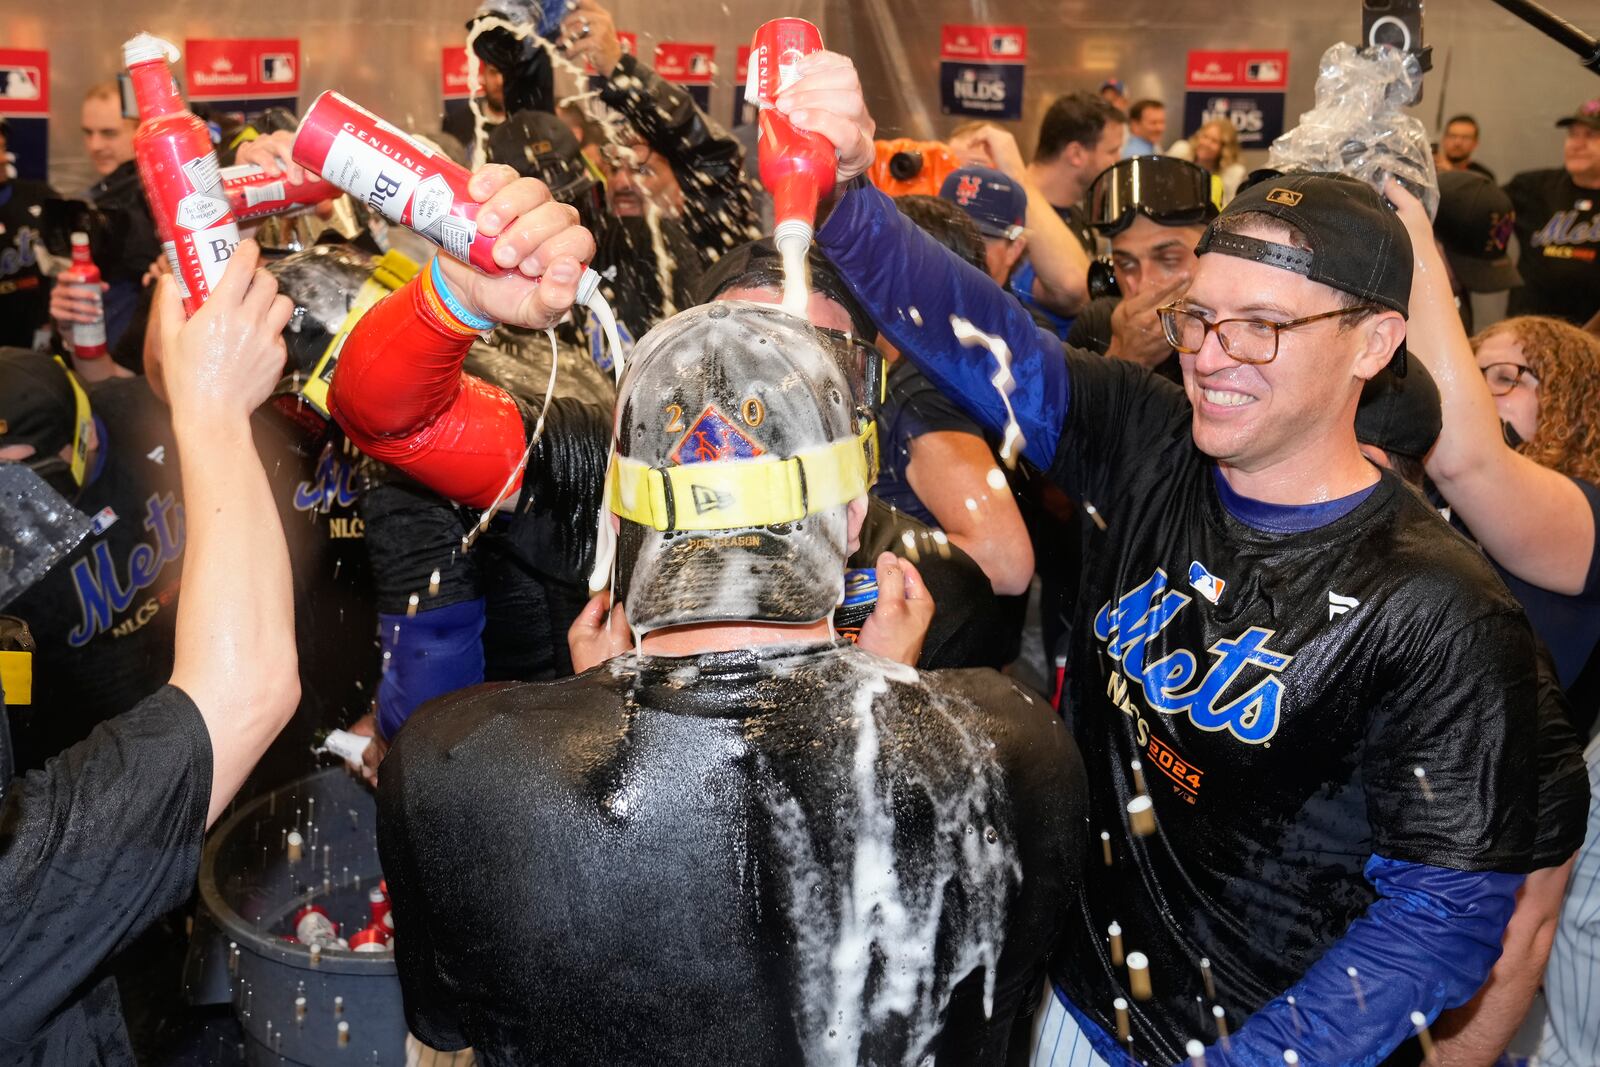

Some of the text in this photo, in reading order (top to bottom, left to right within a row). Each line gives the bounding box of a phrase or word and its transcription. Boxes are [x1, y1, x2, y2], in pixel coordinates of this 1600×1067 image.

[759, 45, 768, 97] GENUI
[343, 122, 426, 175] GENUINE
[183, 234, 209, 302] ENUINE
[665, 404, 685, 433] 2
[68, 491, 186, 648] Met
[112, 598, 161, 639] NLCS
[1094, 566, 1294, 745] Mets
[1147, 740, 1202, 789] 2024
